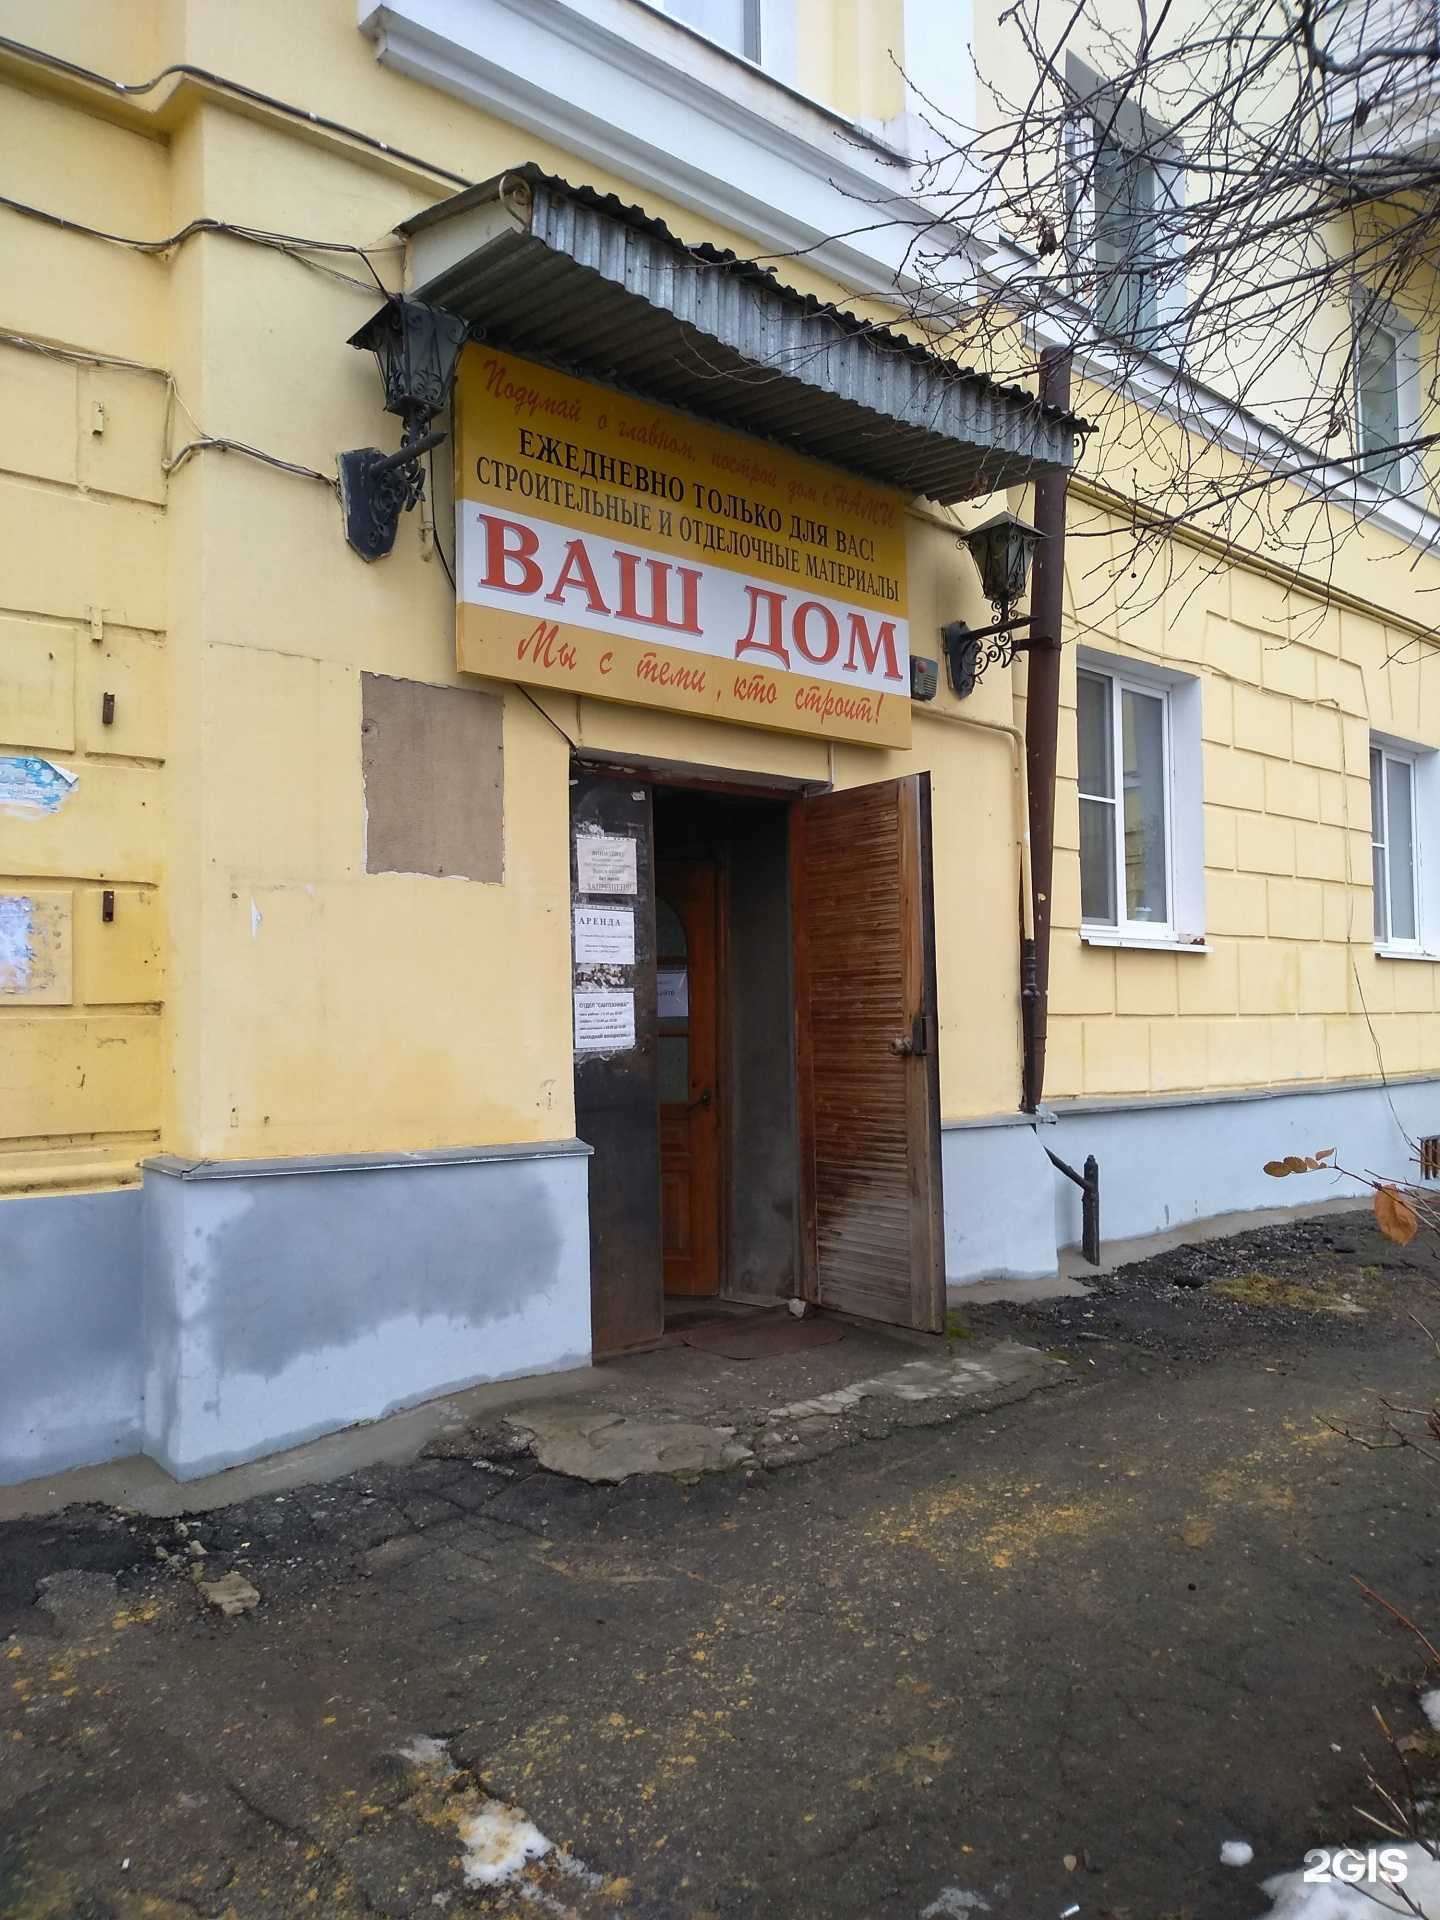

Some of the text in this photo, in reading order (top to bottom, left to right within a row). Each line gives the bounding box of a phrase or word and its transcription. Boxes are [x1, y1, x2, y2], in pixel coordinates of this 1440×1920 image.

[483, 359, 581, 424] Подумай
[597, 415, 608, 430] о
[476, 456, 900, 602] СТРОИТЕЛЬНЫЕ И ОТДЕЛОЧНЫЕ МАТЕРИАЛЫ
[518, 427, 875, 562] ЕЖЕДНЕВНО ТОЛЬКО ДЛЯ ВАС!
[477, 513, 904, 682] ВАШ ДОМ
[517, 620, 577, 671] Мы
[599, 651, 614, 675] с
[733, 674, 778, 704] кто
[794, 686, 885, 725] строит!
[578, 916, 622, 927] АРЕНДА
